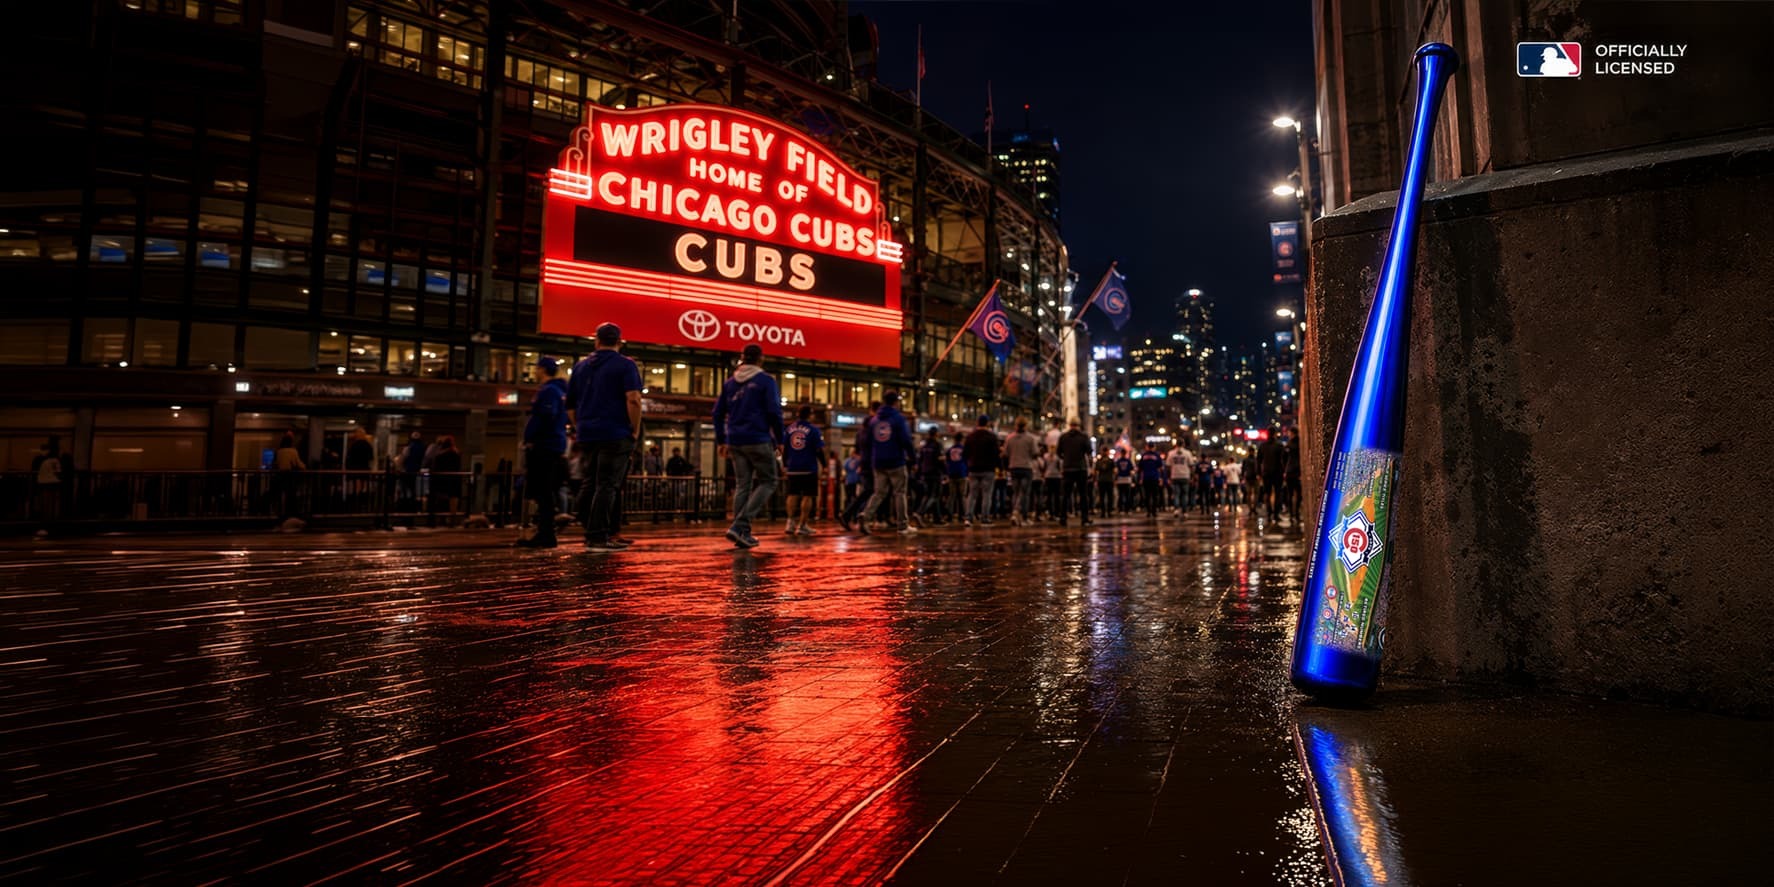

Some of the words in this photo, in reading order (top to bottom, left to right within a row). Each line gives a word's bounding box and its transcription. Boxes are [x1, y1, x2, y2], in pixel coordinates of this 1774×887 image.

[600, 118, 775, 161] WRIGLEY
[787, 141, 873, 215] FIELD
[689, 157, 763, 193] HOME
[778, 180, 809, 202] OF
[598, 171, 777, 235] CHICAGO
[790, 213, 877, 257] CUBS
[675, 232, 816, 291] CUBS
[725, 320, 806, 346] TOYOTA
[1350, 534, 1361, 554] 150
